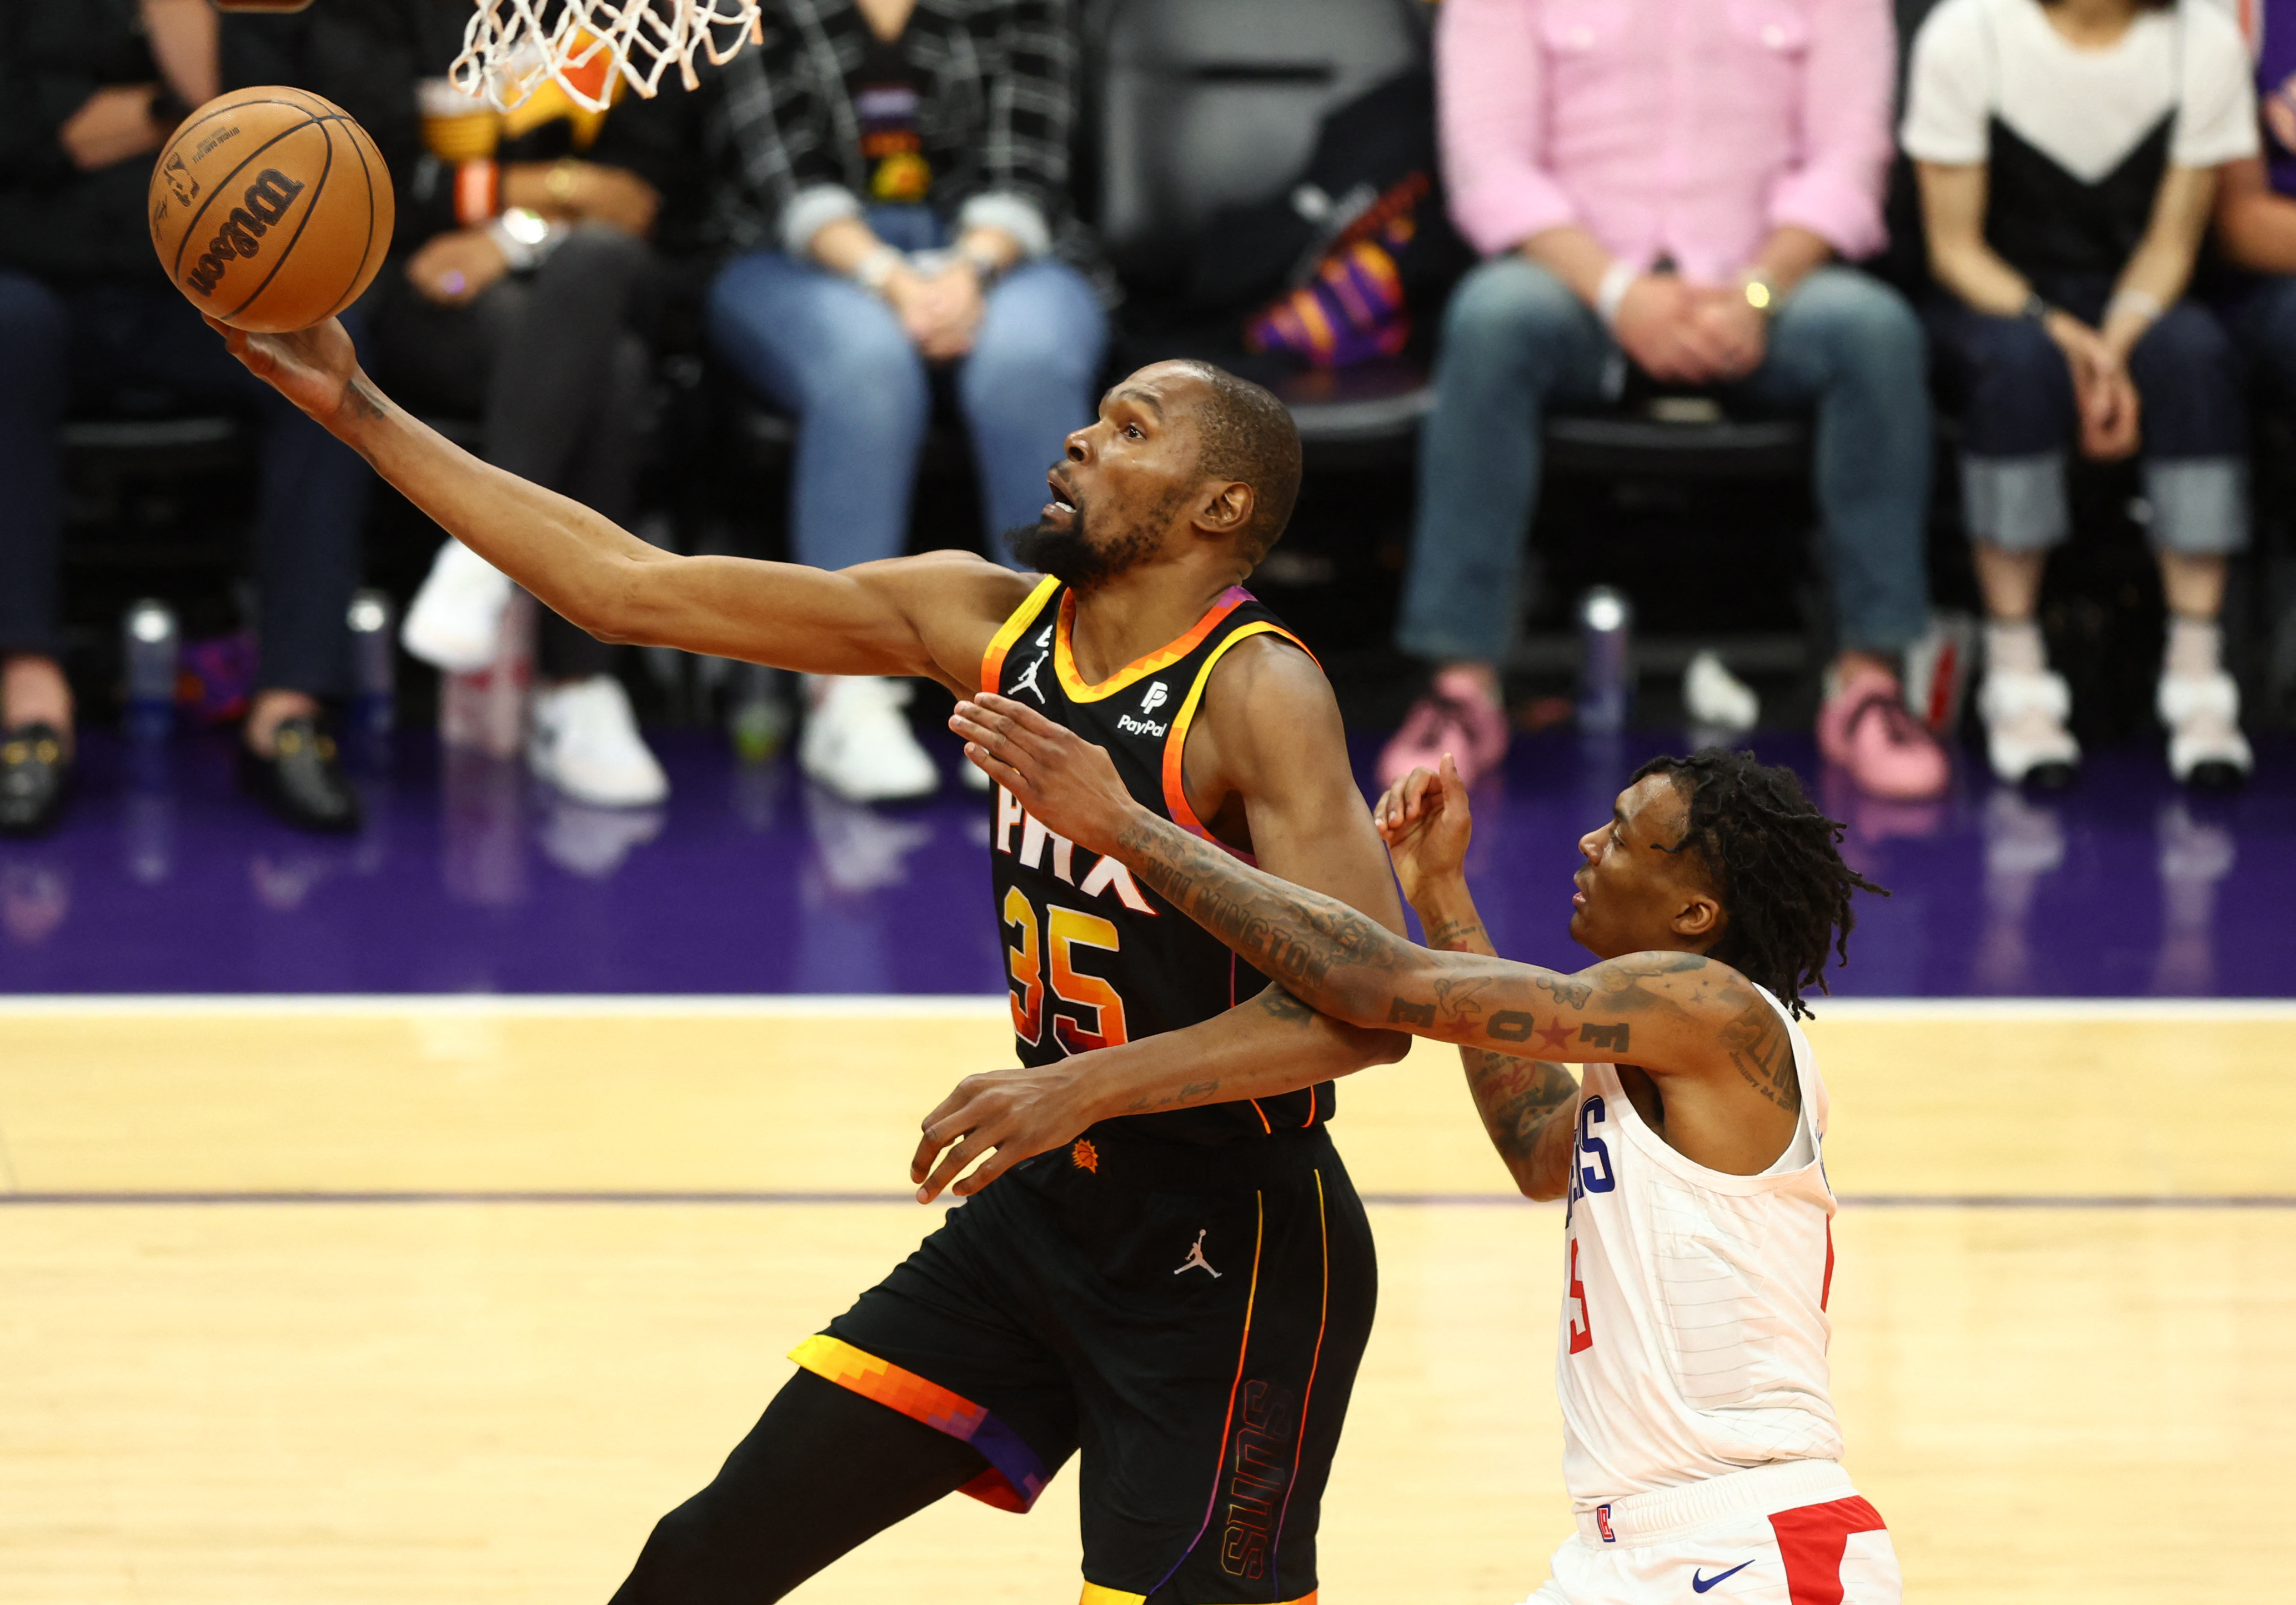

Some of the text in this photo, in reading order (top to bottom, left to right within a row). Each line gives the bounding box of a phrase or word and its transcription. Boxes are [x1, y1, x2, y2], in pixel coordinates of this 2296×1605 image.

[186, 168, 305, 297] Wilson
[1117, 714, 1167, 737] PayPal
[1004, 885, 1129, 1056] 35
[1146, 856, 1335, 988] WILMINGTON
[1570, 1238, 1593, 1354] 5
[1221, 1379, 1294, 1581] SUNS
